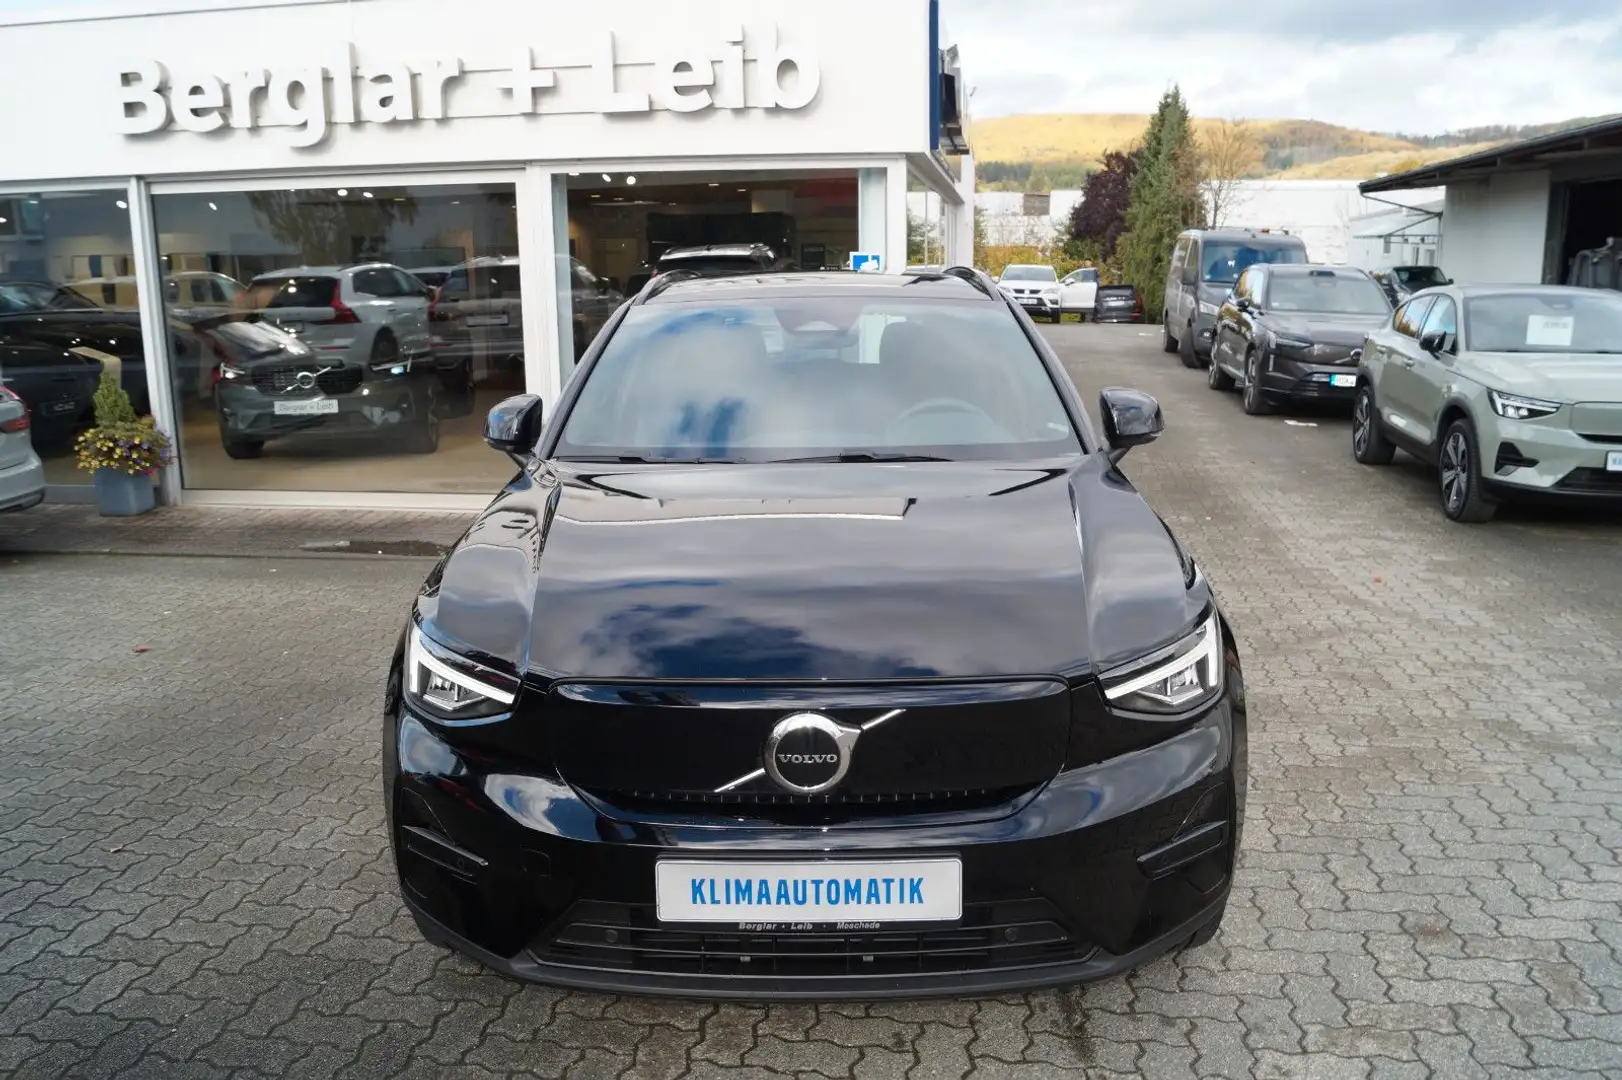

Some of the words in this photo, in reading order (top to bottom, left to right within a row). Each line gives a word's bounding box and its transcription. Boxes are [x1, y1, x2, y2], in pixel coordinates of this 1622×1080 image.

[113, 41, 462, 148] Berglar
[593, 23, 821, 116] Leib
[777, 753, 838, 764] VOLVO
[691, 877, 924, 905] KLIMAAUTOMATIK
